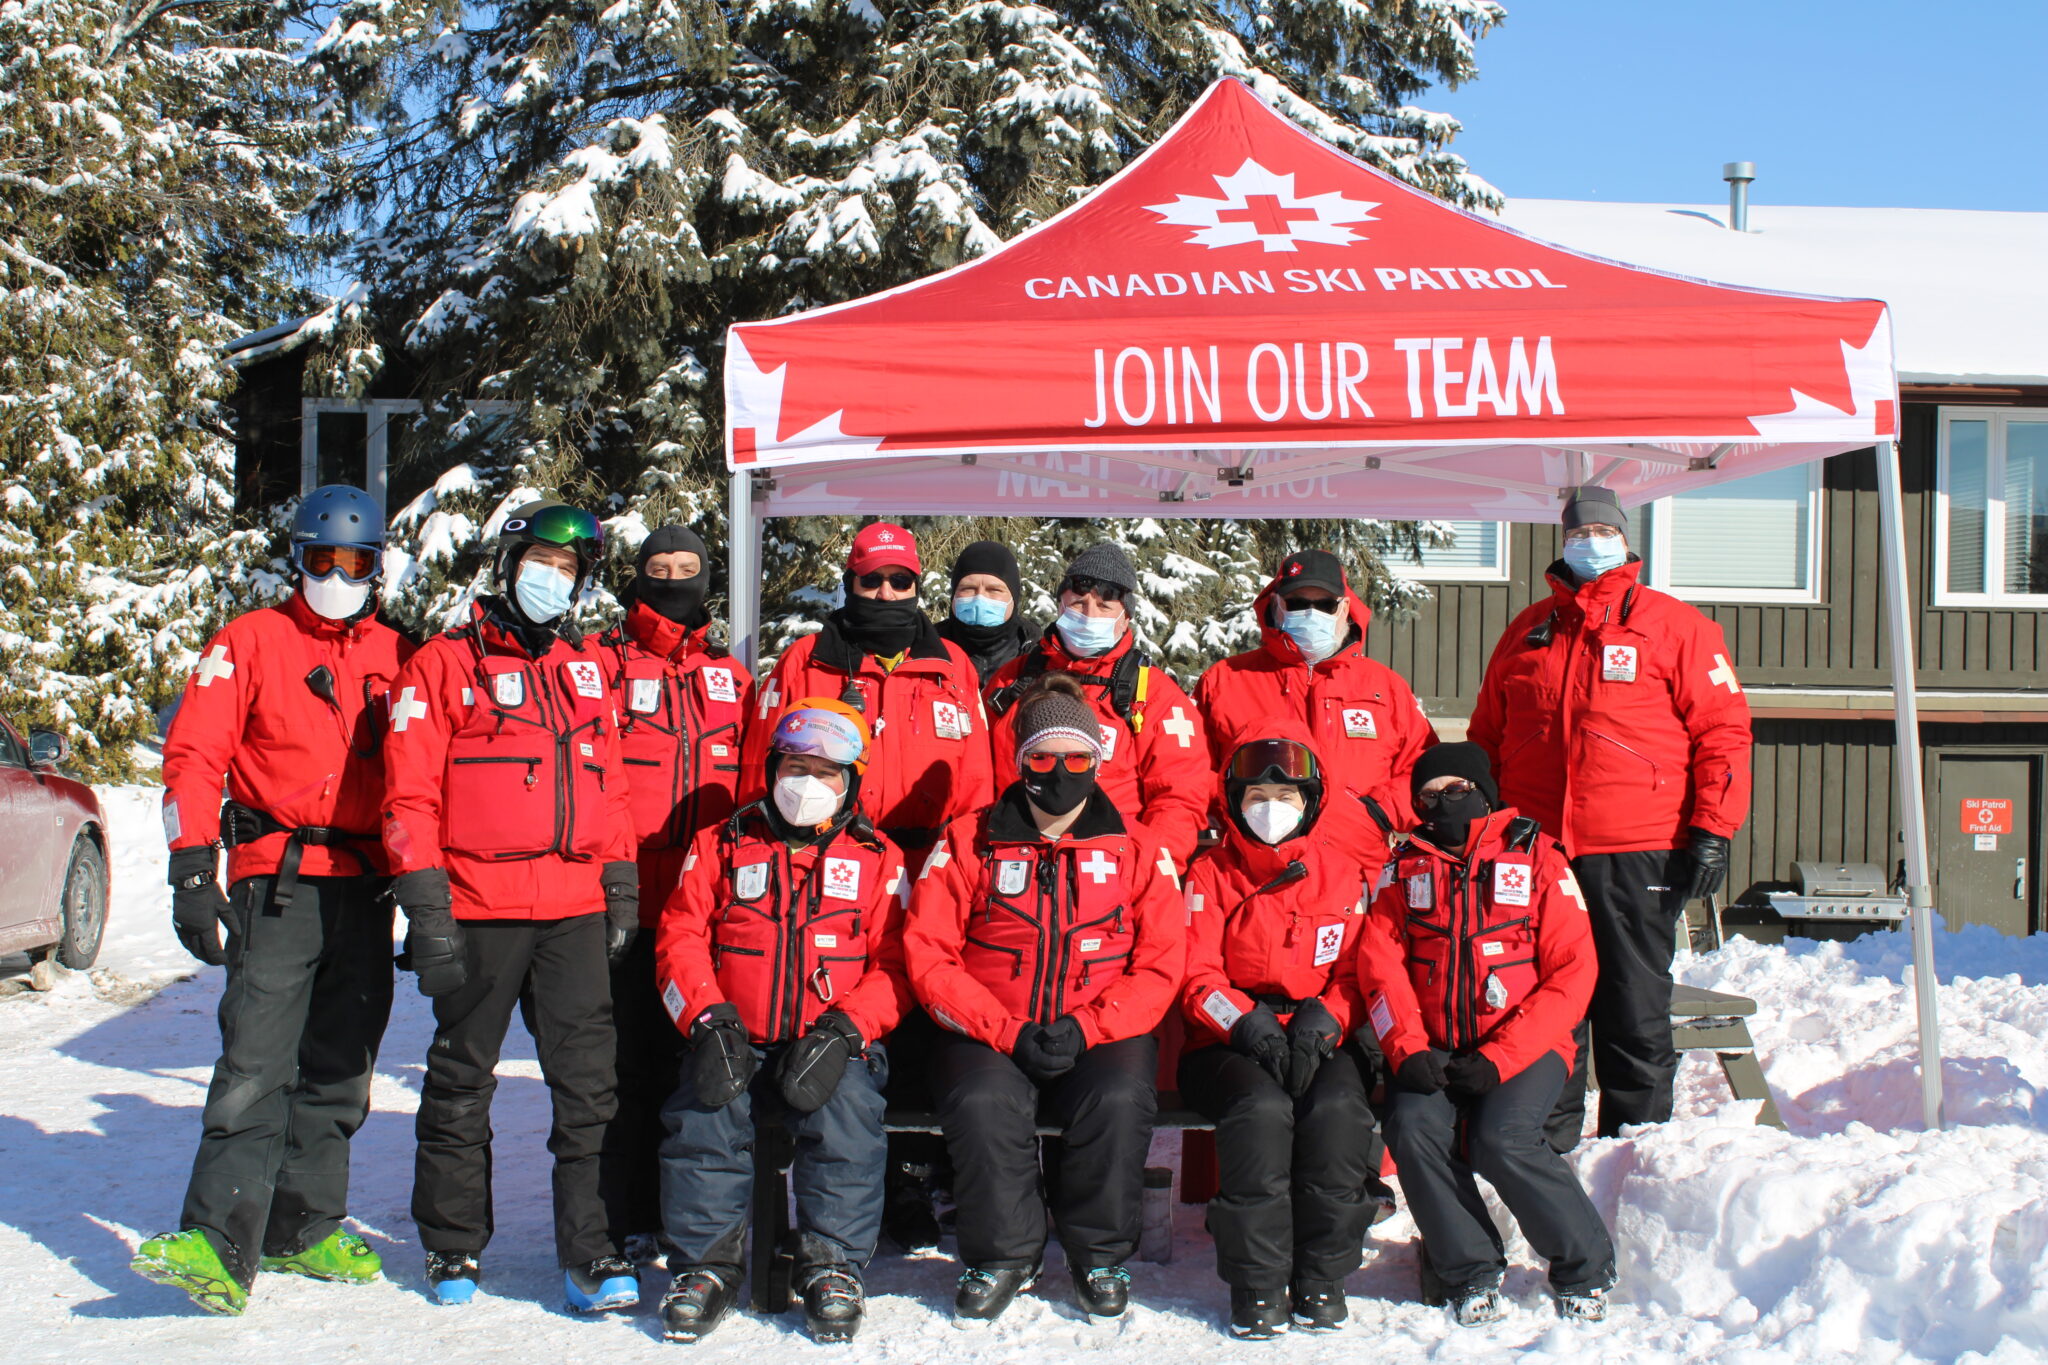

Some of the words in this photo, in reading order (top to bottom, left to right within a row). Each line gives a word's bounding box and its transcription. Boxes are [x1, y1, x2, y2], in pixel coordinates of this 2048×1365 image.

[1024, 270, 1275, 299] CANADIAN
[1283, 268, 1366, 293] SKI
[1373, 268, 1568, 291] PATROL
[1084, 346, 1222, 428] JOIN
[1247, 342, 1375, 422] OUR
[1394, 336, 1565, 418] TEAM
[1966, 800, 1979, 809] Ski
[1982, 800, 2006, 809] Patrol
[1969, 824, 1987, 832] First
[1988, 824, 2001, 832] Aid
